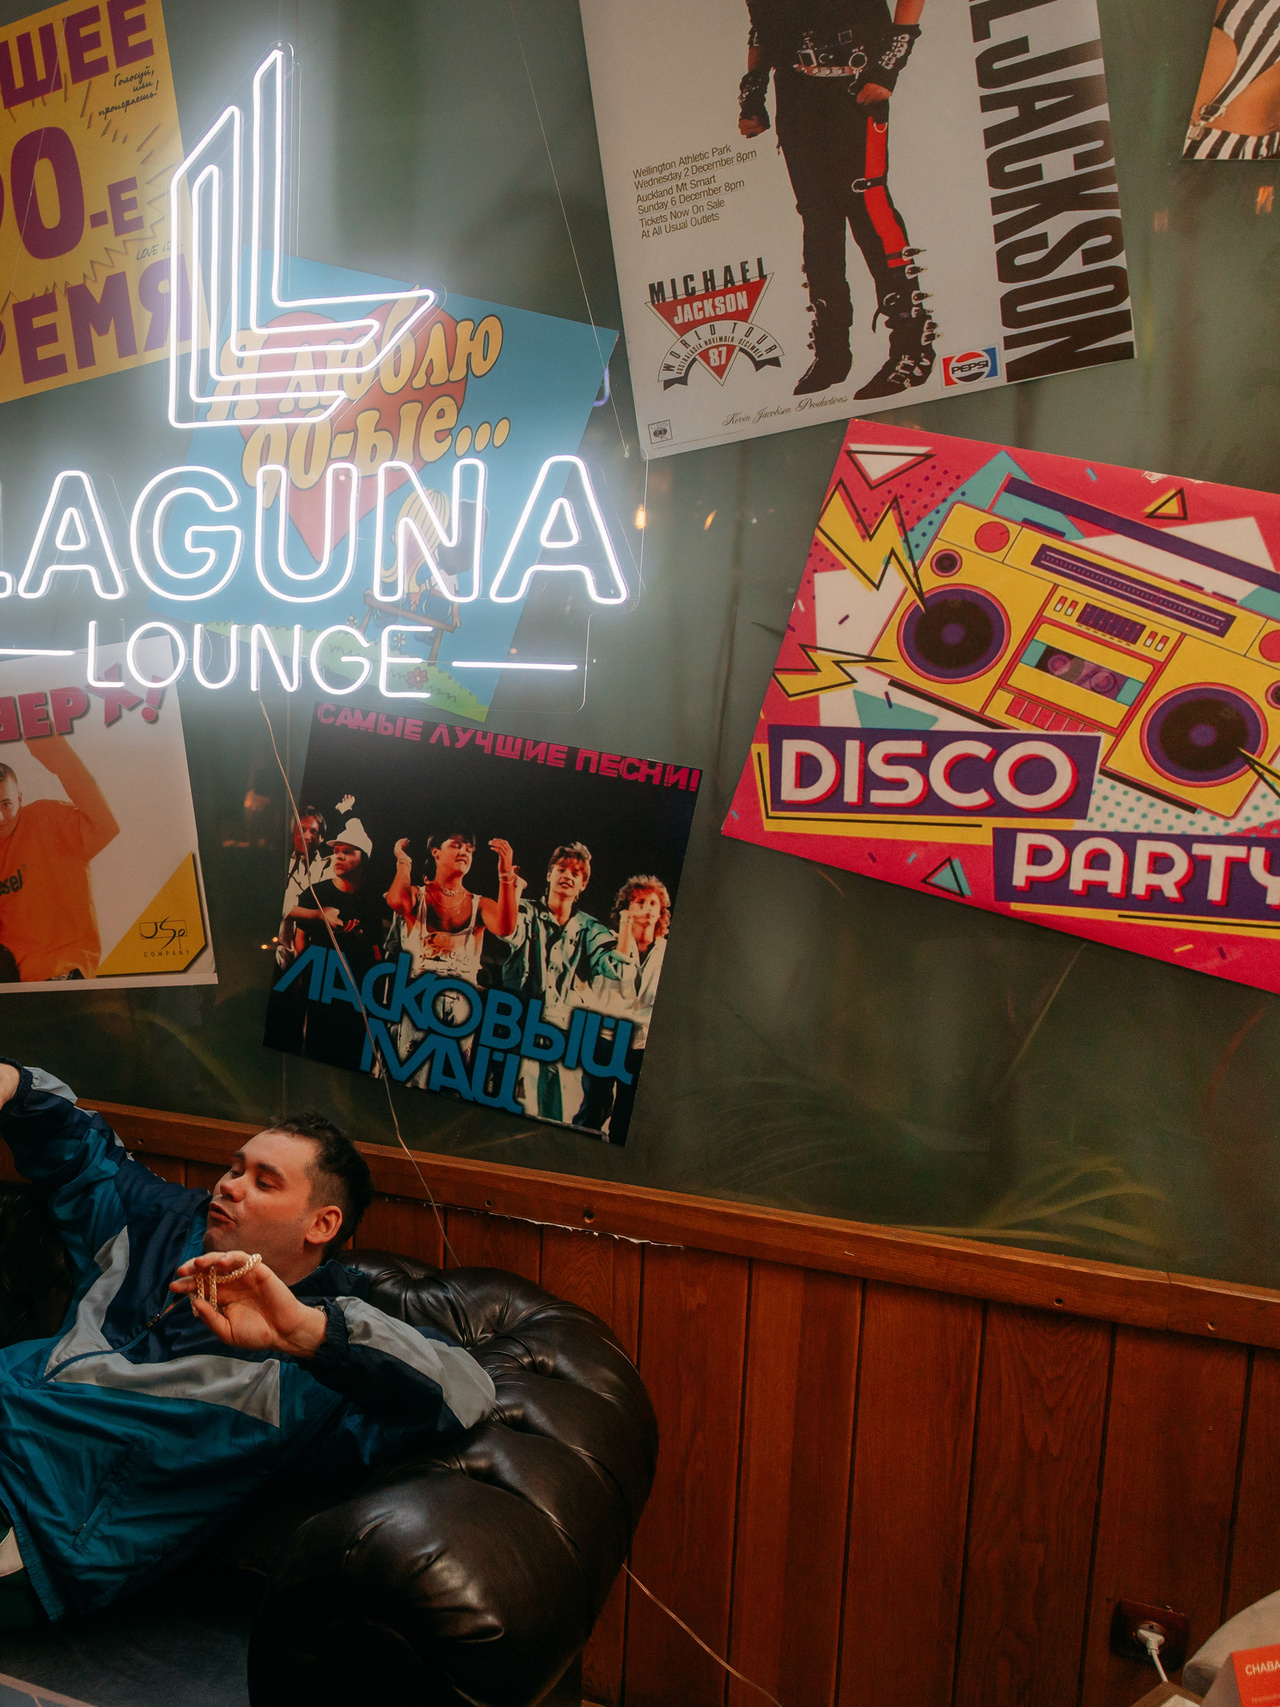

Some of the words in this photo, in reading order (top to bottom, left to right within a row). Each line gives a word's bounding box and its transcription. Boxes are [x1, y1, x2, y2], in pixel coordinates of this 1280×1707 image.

[633, 161, 676, 179] Wellington
[678, 151, 709, 166] Athletic
[711, 144, 731, 157] Park
[634, 171, 682, 190] Wednesday
[683, 168, 689, 177] 2
[691, 156, 734, 175] December
[736, 150, 757, 163] 8pm
[636, 186, 673, 204] Auckland
[675, 182, 687, 193] Mt
[690, 174, 716, 189] Smart
[638, 200, 668, 215] Sunday
[670, 197, 677, 206] 6
[679, 186, 722, 205] December
[724, 180, 745, 193] 8pm
[639, 214, 667, 228] Tickets
[670, 208, 689, 220] Now
[692, 204, 704, 214] On
[706, 199, 725, 211] Sale
[641, 229, 650, 239] At
[652, 225, 662, 237] All
[664, 220, 688, 234] Usual
[690, 212, 720, 227] Outlets
[975, 36, 1134, 383] JACKSON
[136, 243, 159, 260] LOVE
[649, 257, 767, 305] MICHAEL
[673, 291, 748, 324] JACKSON
[662, 324, 716, 372] WORLD
[731, 322, 778, 354] TOUR
[708, 346, 727, 366] 87
[951, 359, 989, 375] PEPSI
[88, 620, 432, 697] LOUNGE
[317, 702, 424, 741] САМЫЕ
[429, 724, 567, 767] ЛУЧШИЕ
[780, 739, 1077, 811] DISCO
[273, 943, 634, 1085] ЛАСКОВЫЙ
[360, 1018, 524, 1112] МАЙ
